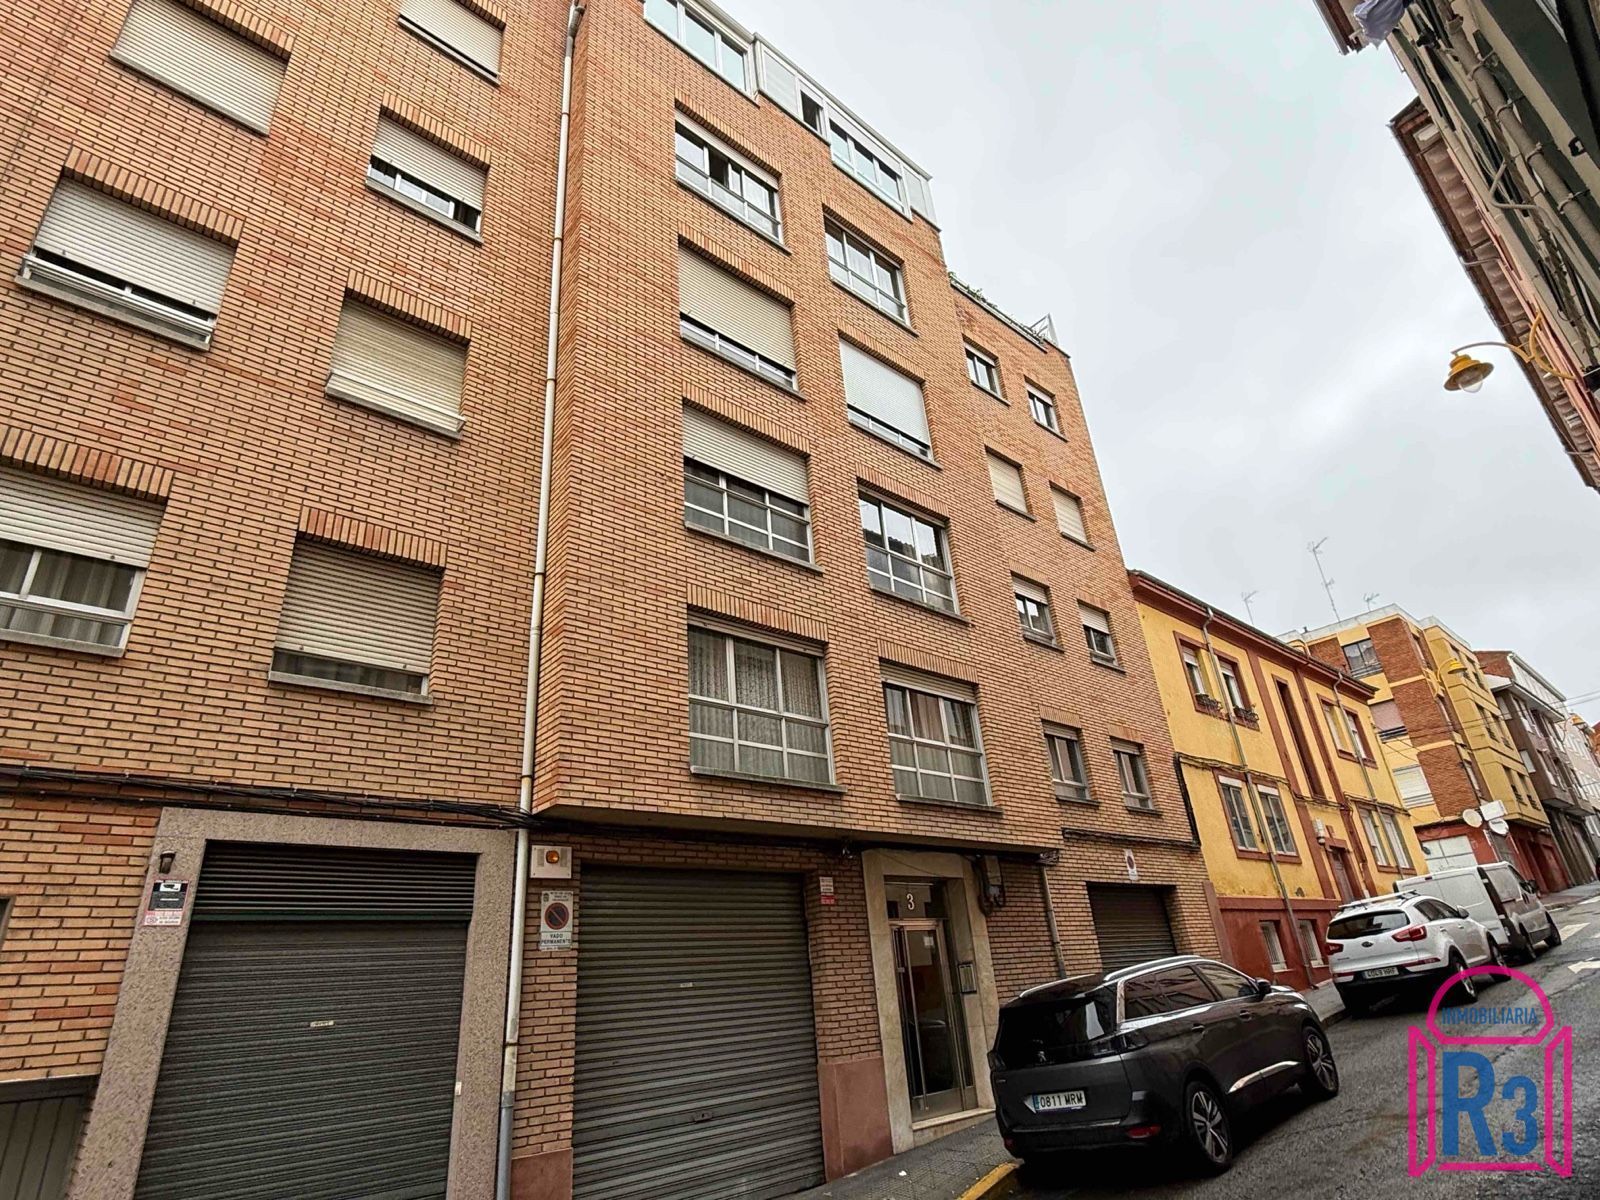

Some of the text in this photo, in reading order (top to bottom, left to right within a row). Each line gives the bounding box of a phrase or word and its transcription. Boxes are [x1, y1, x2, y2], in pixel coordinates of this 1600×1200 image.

[906, 893, 915, 910] 3
[1040, 1092, 1084, 1108] 0811 MRM
